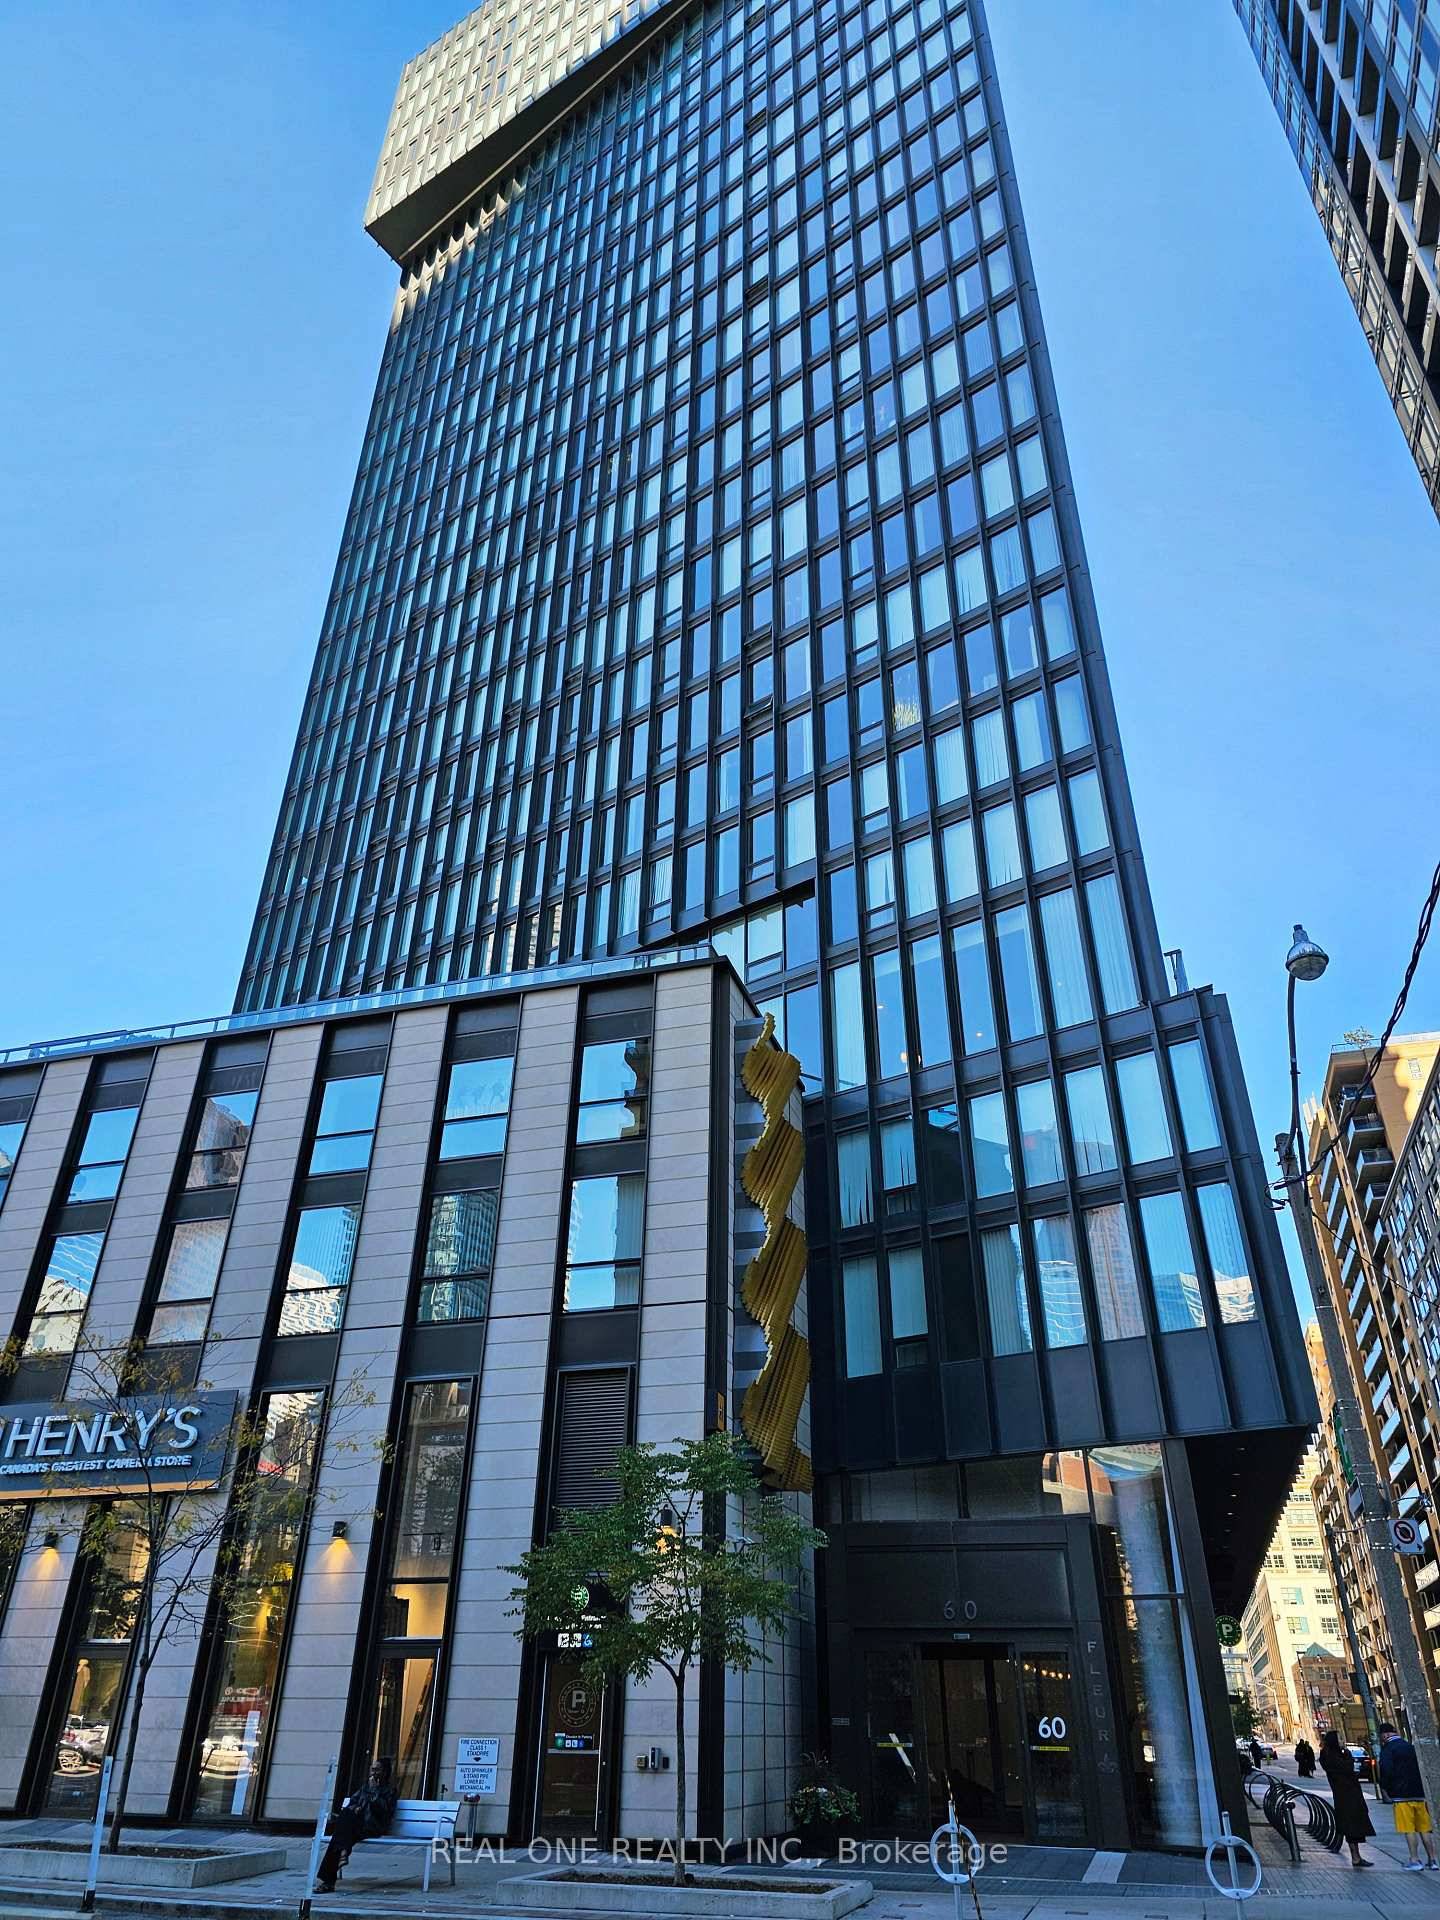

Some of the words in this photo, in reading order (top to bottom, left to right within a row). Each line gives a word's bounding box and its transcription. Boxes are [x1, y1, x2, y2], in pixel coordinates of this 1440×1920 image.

[4, 1405, 202, 1458] HENRY'S
[0, 1462, 49, 1475] CANADA'S
[51, 1459, 105, 1473] GREATEST
[154, 1454, 193, 1467] STORE
[943, 1600, 977, 1620] 60
[1221, 1623, 1234, 1636] P
[1087, 1640, 1110, 1742] FLEUR
[1038, 1716, 1067, 1739] 60
